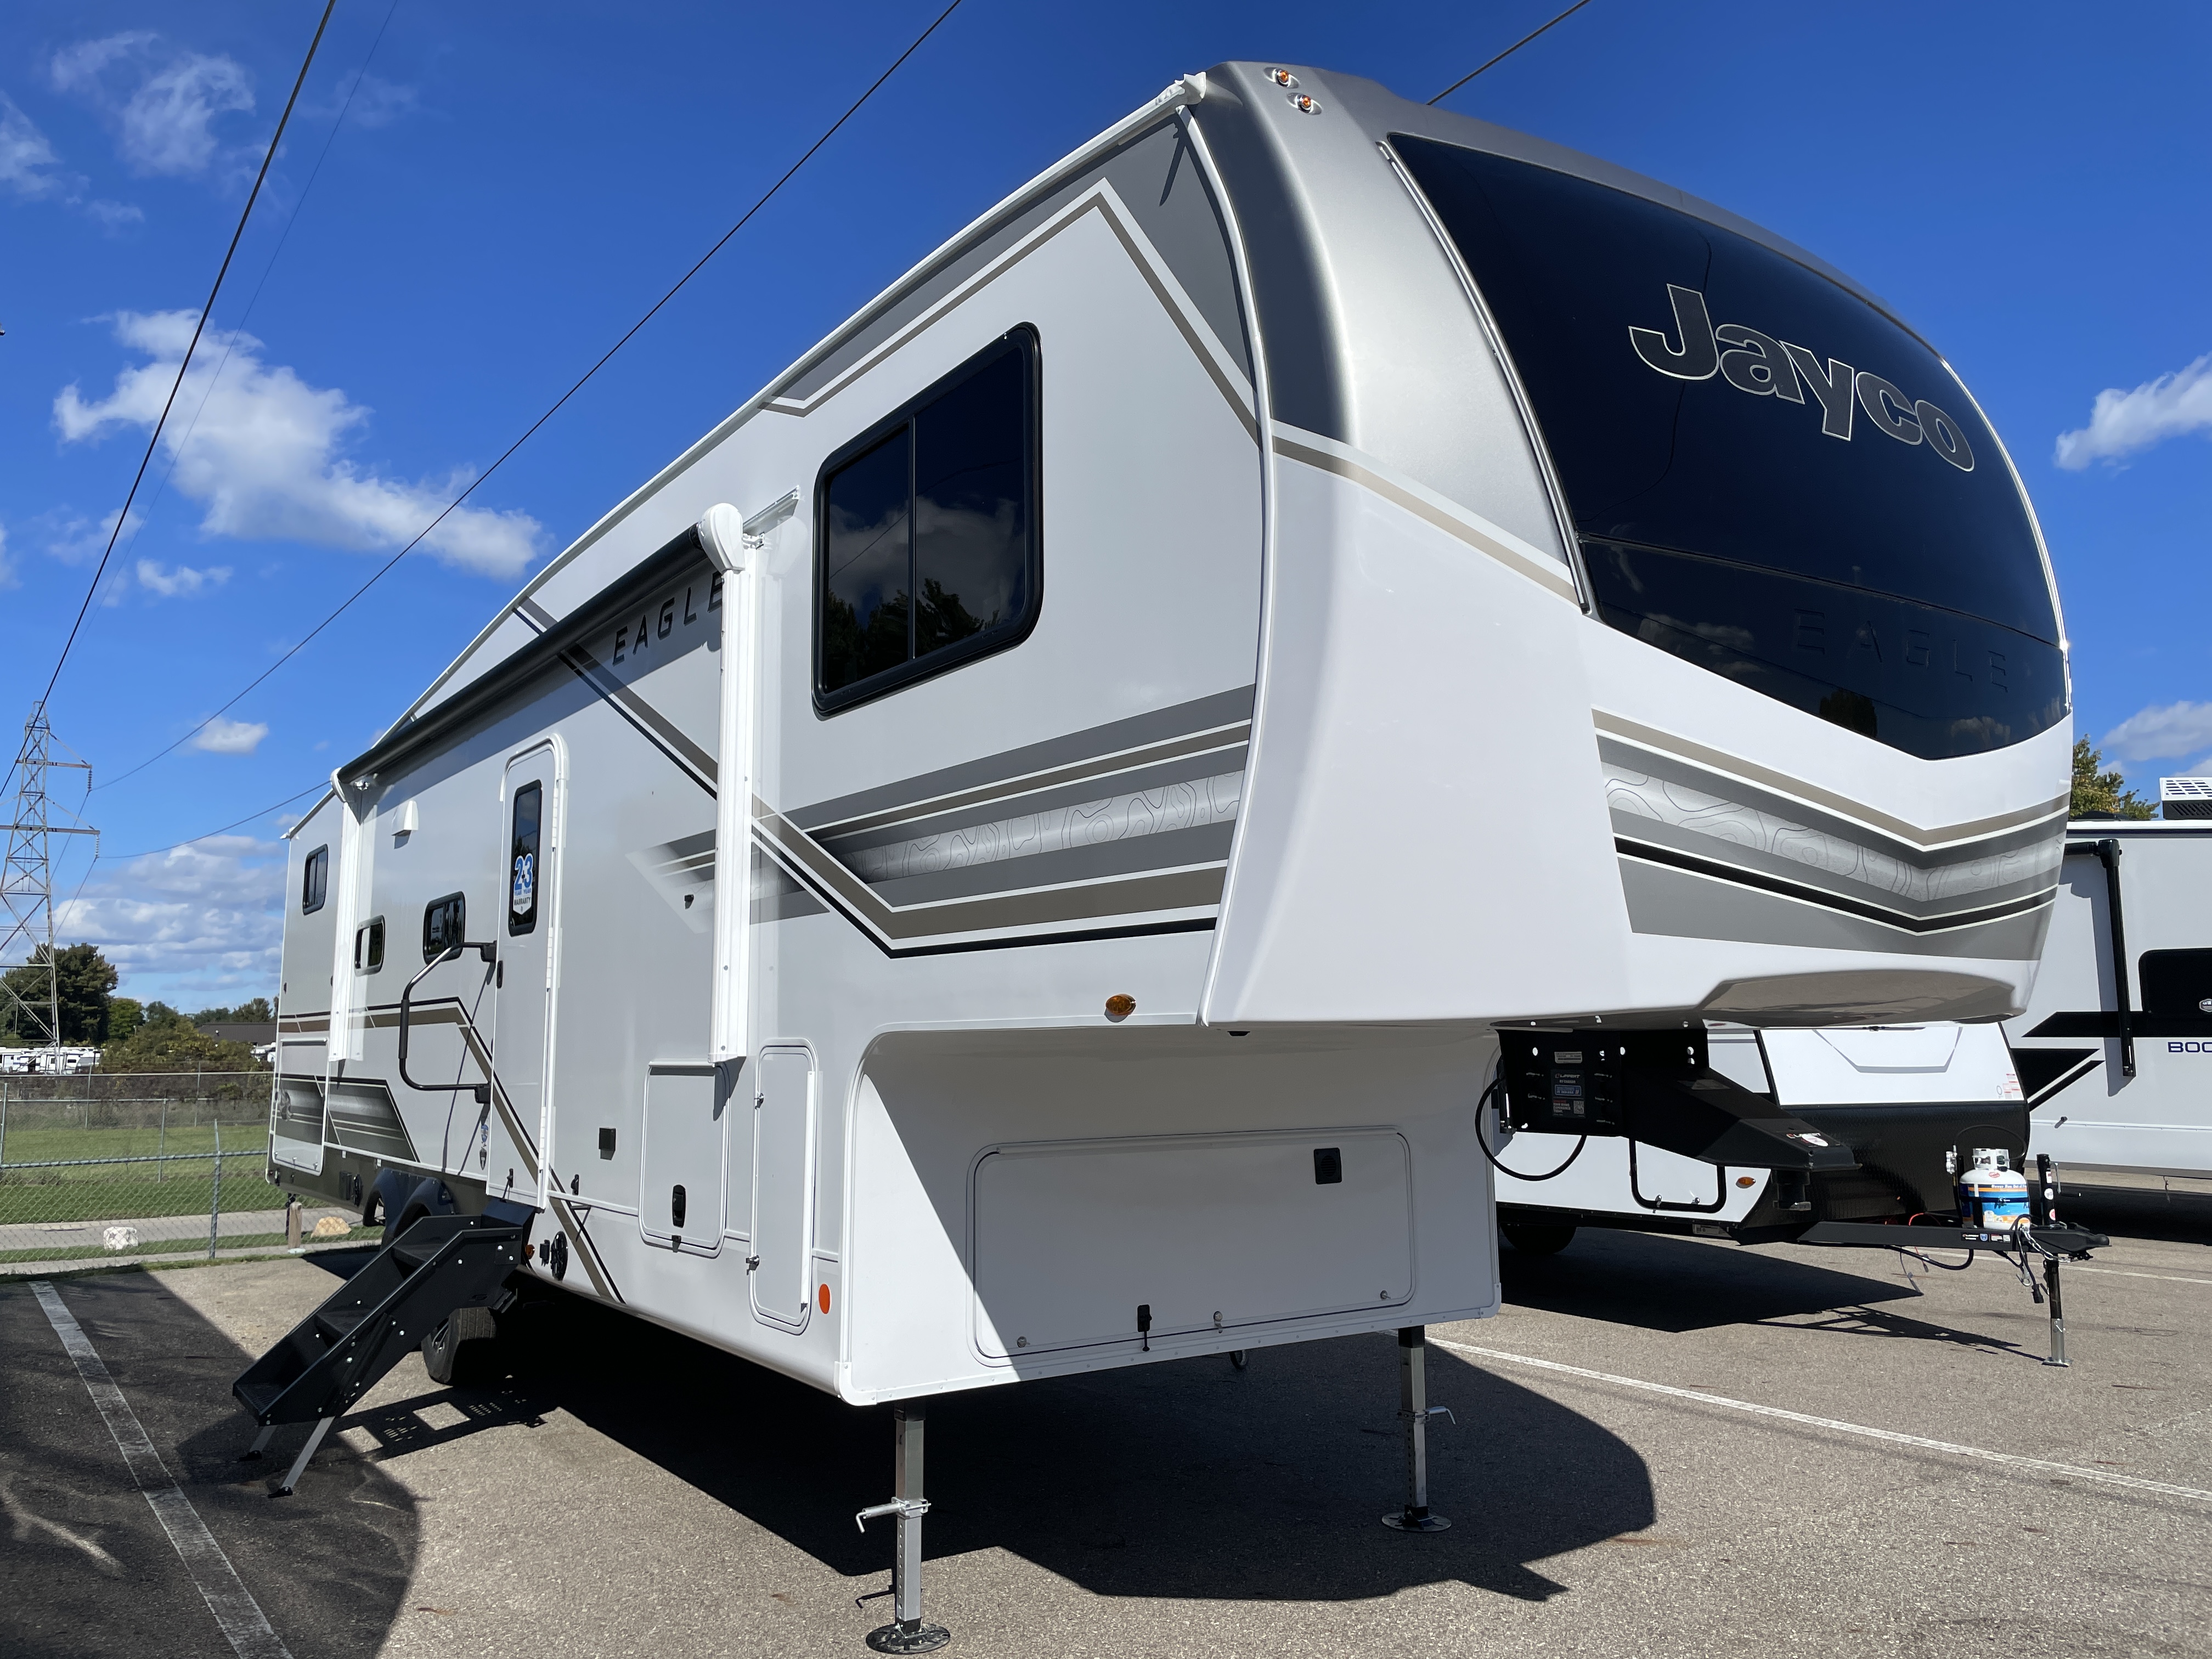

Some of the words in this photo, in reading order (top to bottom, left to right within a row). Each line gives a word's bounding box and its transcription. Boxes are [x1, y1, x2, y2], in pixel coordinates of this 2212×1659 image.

[1628, 284, 1974, 472] Jayco
[612, 571, 723, 667] EAGLE
[1794, 608, 2009, 693] EAGLE
[514, 897, 531, 905] WARRANTY
